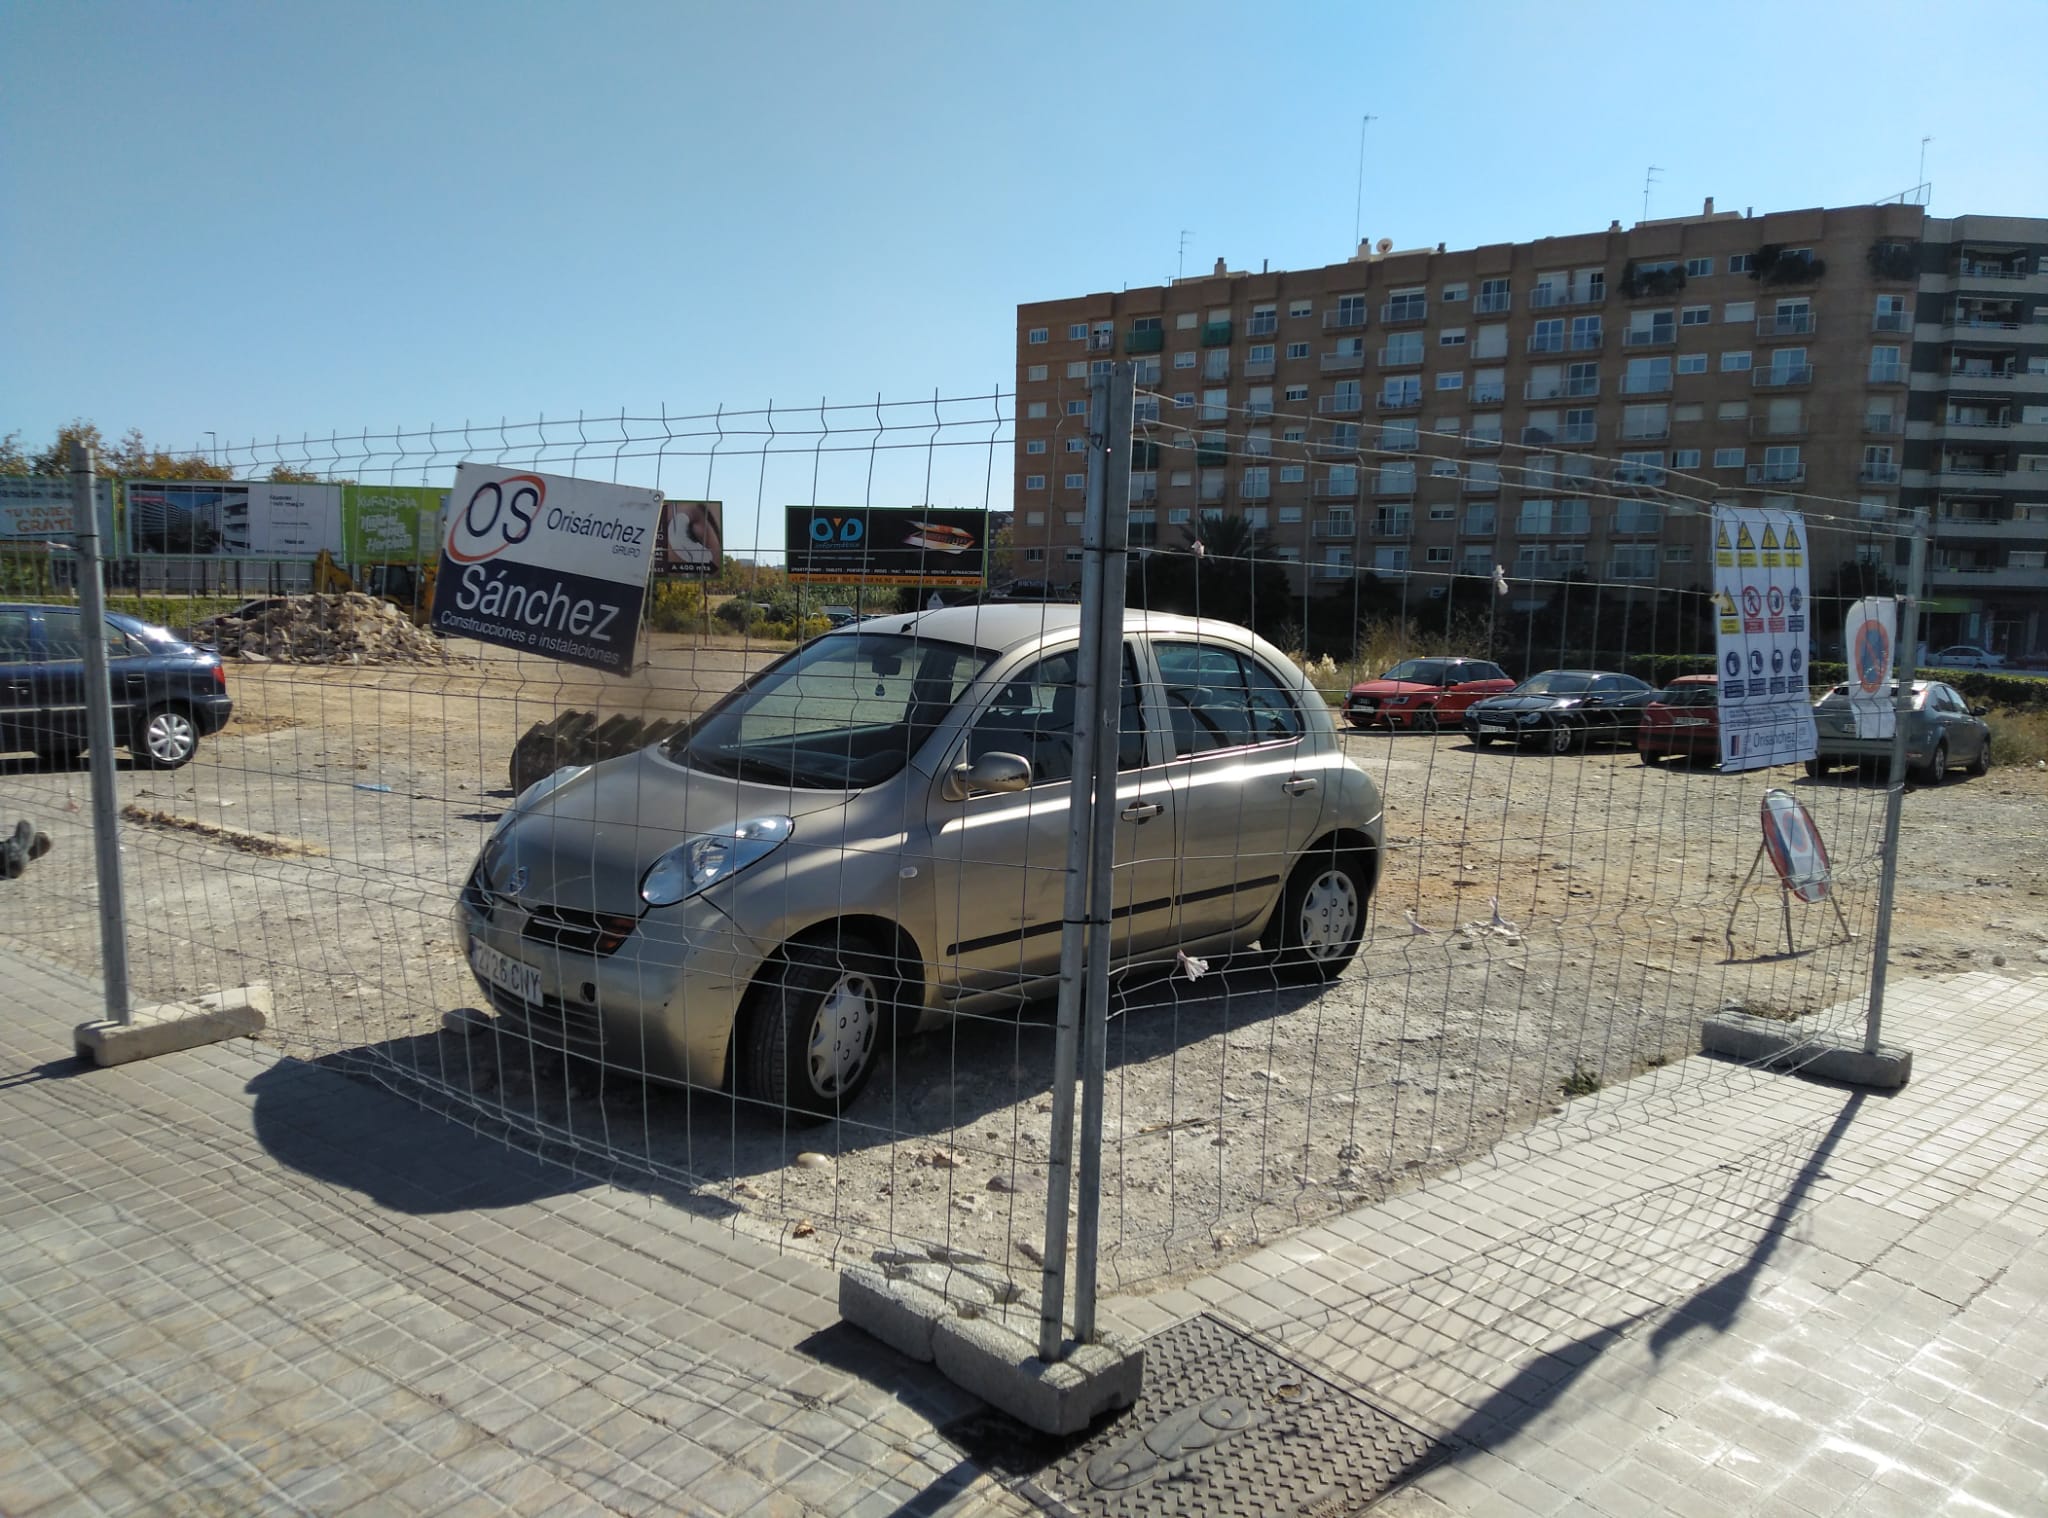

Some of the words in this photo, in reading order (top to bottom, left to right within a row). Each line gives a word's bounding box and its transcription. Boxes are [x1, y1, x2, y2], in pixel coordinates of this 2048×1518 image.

[466, 482, 539, 544] OS
[547, 507, 646, 545] Orisánchez
[612, 545, 640, 558] GRUPO
[456, 564, 620, 642] Sánchez
[440, 610, 525, 644] Construcciones
[528, 633, 537, 645] e
[539, 632, 620, 665] instalaciones
